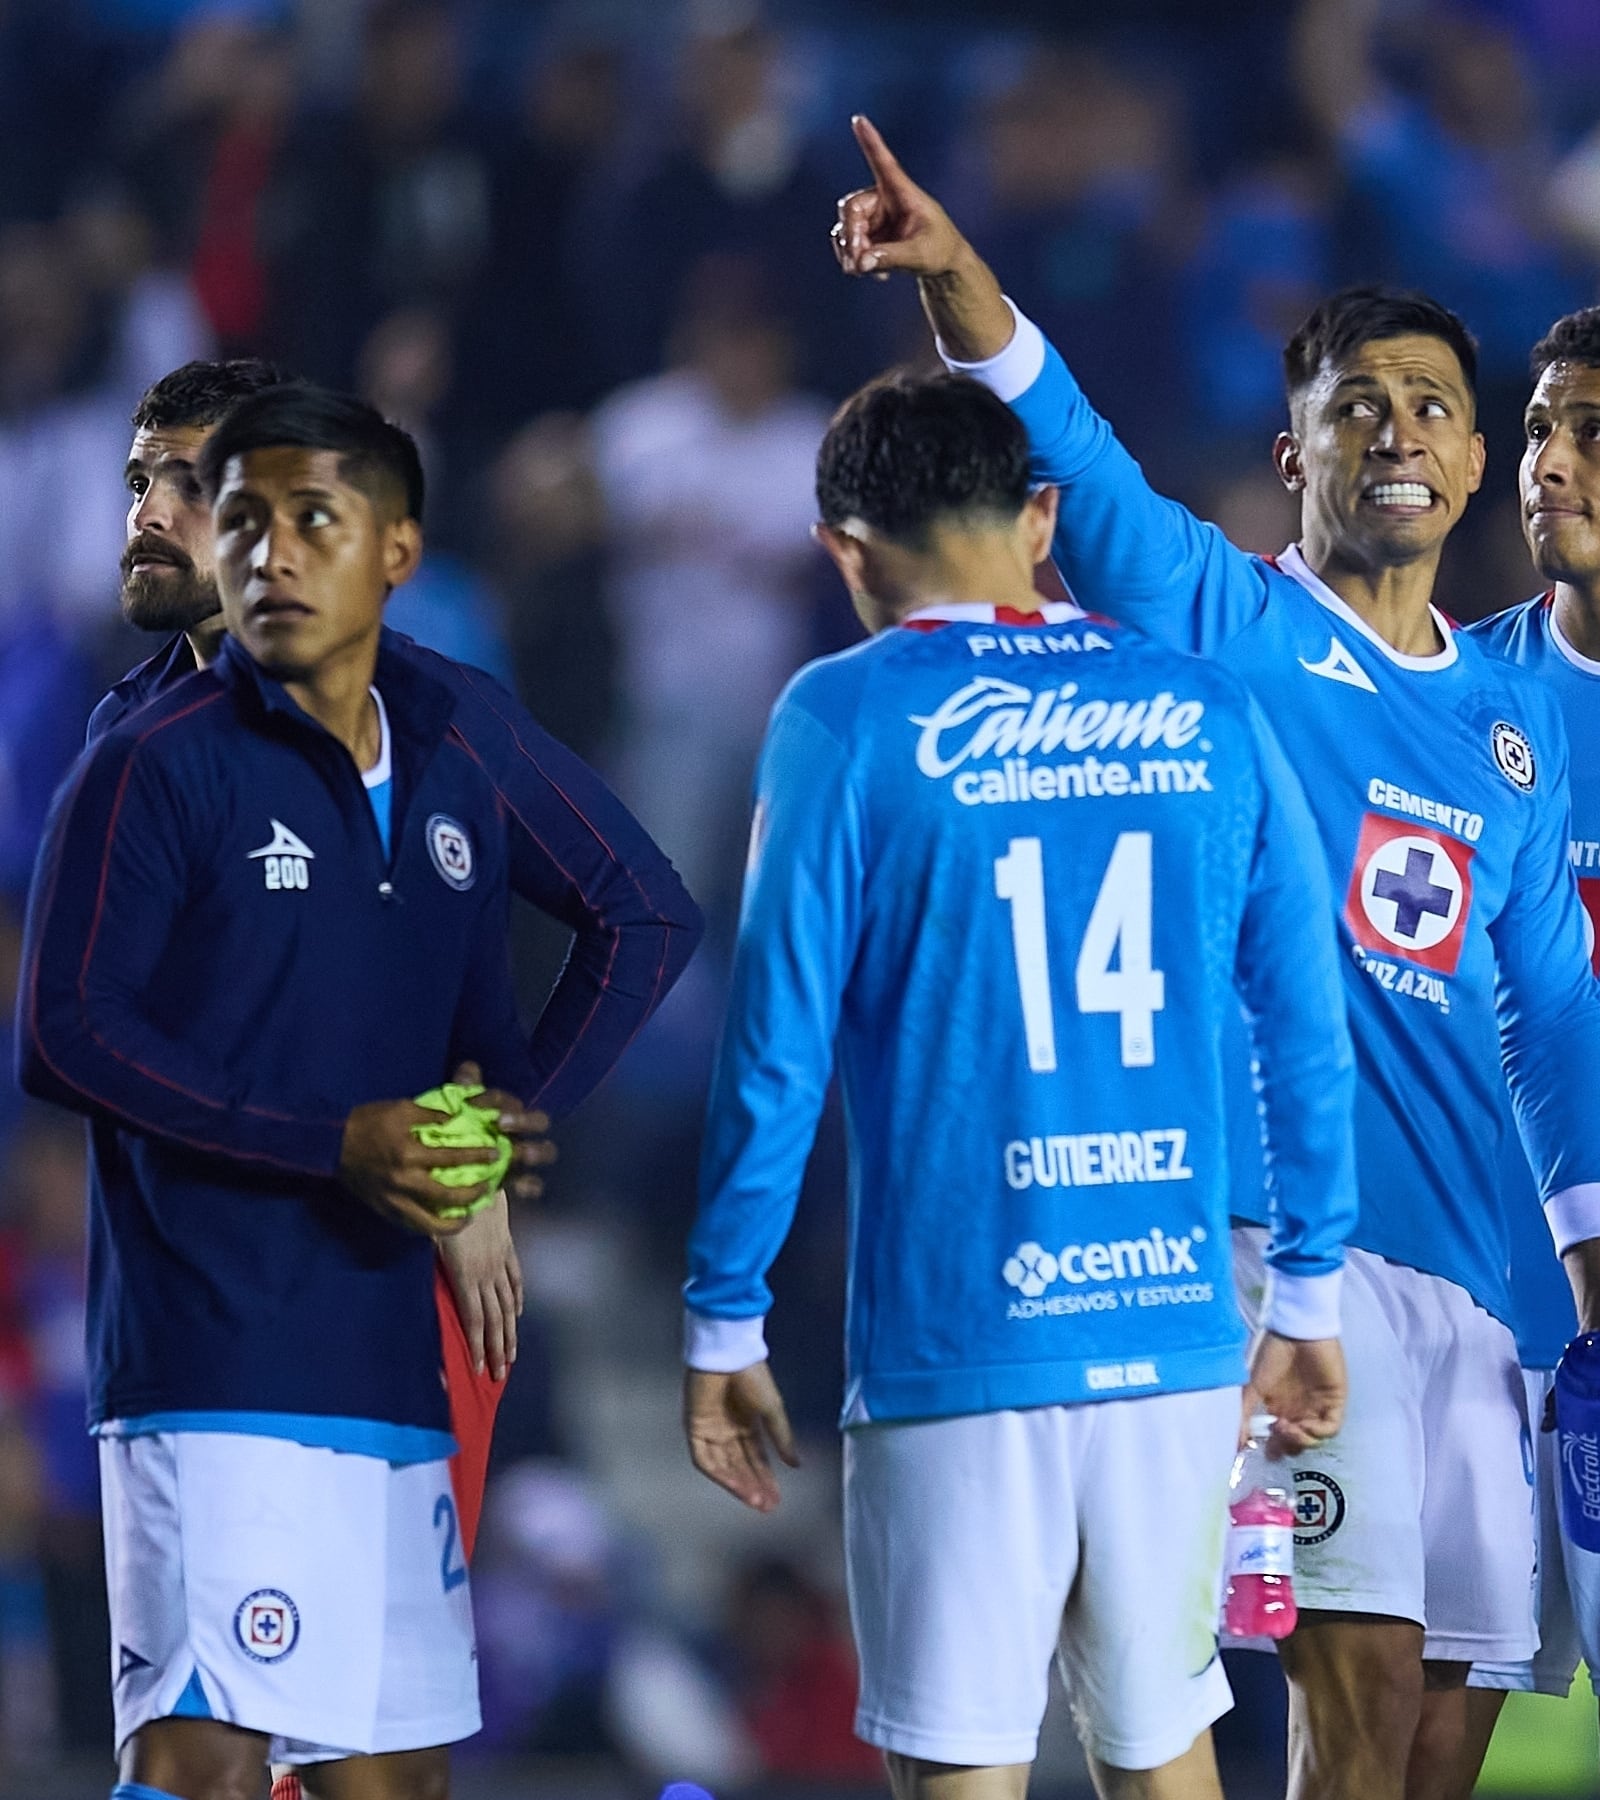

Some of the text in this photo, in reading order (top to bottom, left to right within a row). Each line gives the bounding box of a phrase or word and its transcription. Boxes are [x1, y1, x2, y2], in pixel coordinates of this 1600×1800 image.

[966, 631, 1114, 657] PIRMA
[907, 674, 1206, 780] Caliente
[952, 755, 1214, 806] caliente.mx
[1367, 777, 1484, 843] CEMENTO
[265, 856, 309, 890] 200
[995, 831, 1165, 1073] 14
[1395, 969, 1450, 1006] AZUL
[1004, 1128, 1194, 1190] GUTIERREZ
[1059, 1226, 1199, 1284] cemix
[1007, 1282, 1214, 1320] ADHESIVOS Y ESTUCOS
